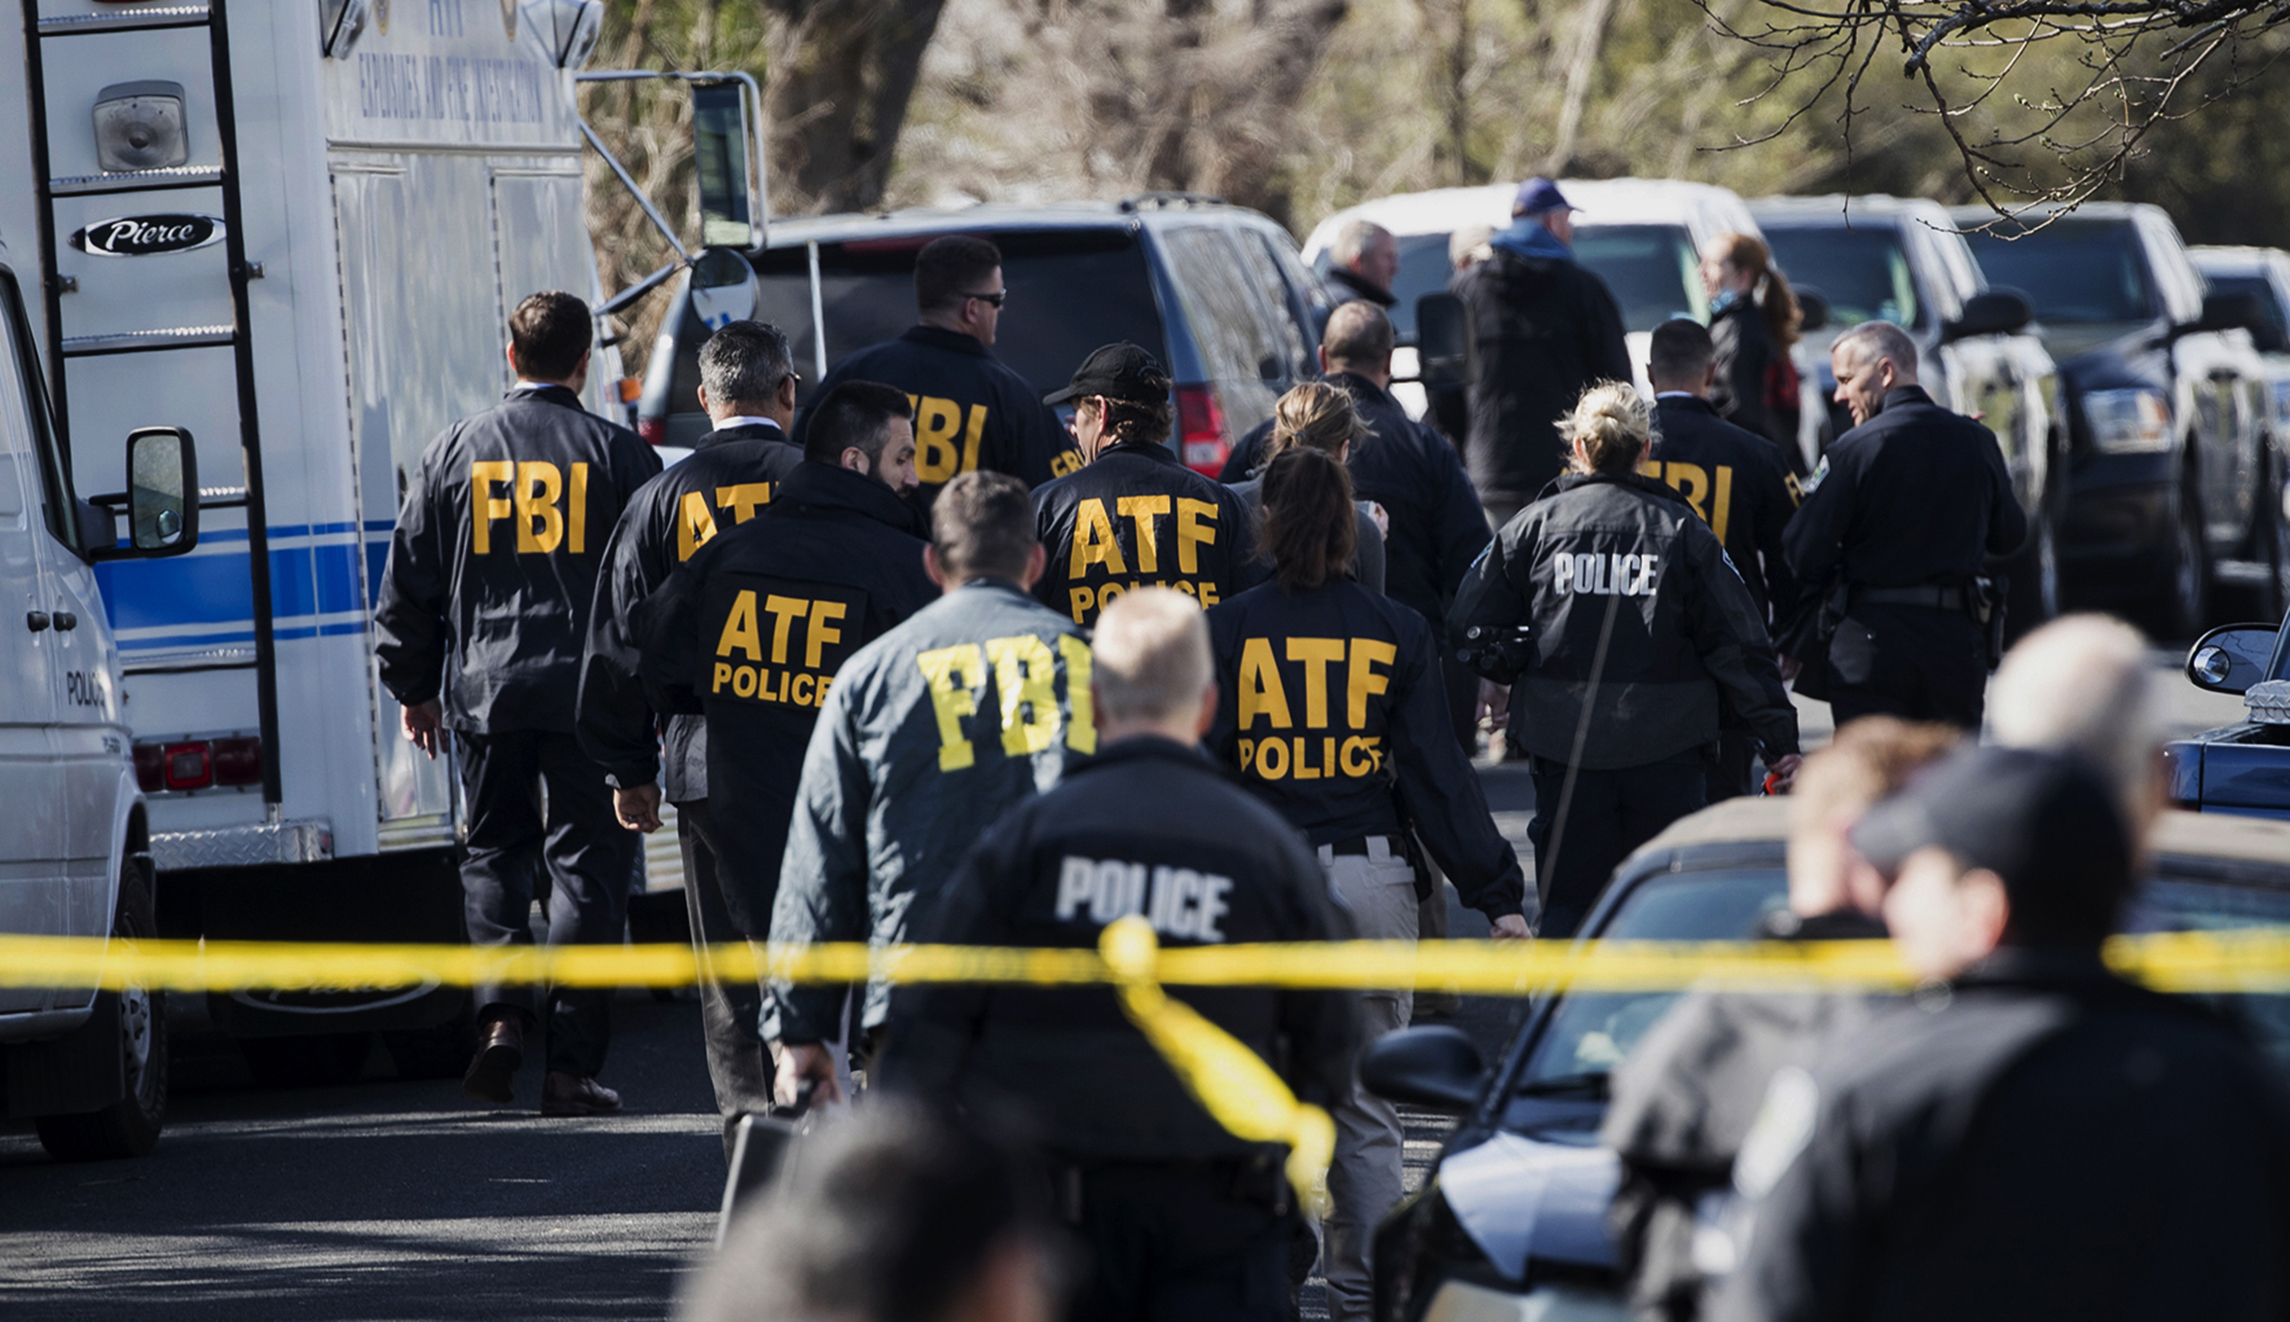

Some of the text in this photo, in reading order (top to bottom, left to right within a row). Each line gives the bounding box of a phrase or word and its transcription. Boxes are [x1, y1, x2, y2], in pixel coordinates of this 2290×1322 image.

[105, 220, 195, 251] Pierce
[907, 393, 988, 484] BI
[472, 461, 588, 554] FBI
[677, 481, 780, 562] AT
[1069, 495, 1219, 580] ATF
[1638, 461, 1732, 547] BI
[1069, 580, 1220, 624] POE
[1554, 552, 1658, 596] POLICE
[716, 589, 847, 668] ATF
[712, 662, 834, 707] POLICE
[917, 633, 1098, 772] FBI
[1238, 637, 1397, 731] ATF
[1238, 735, 1383, 780] POLICE
[1055, 856, 1234, 943] POLICE
